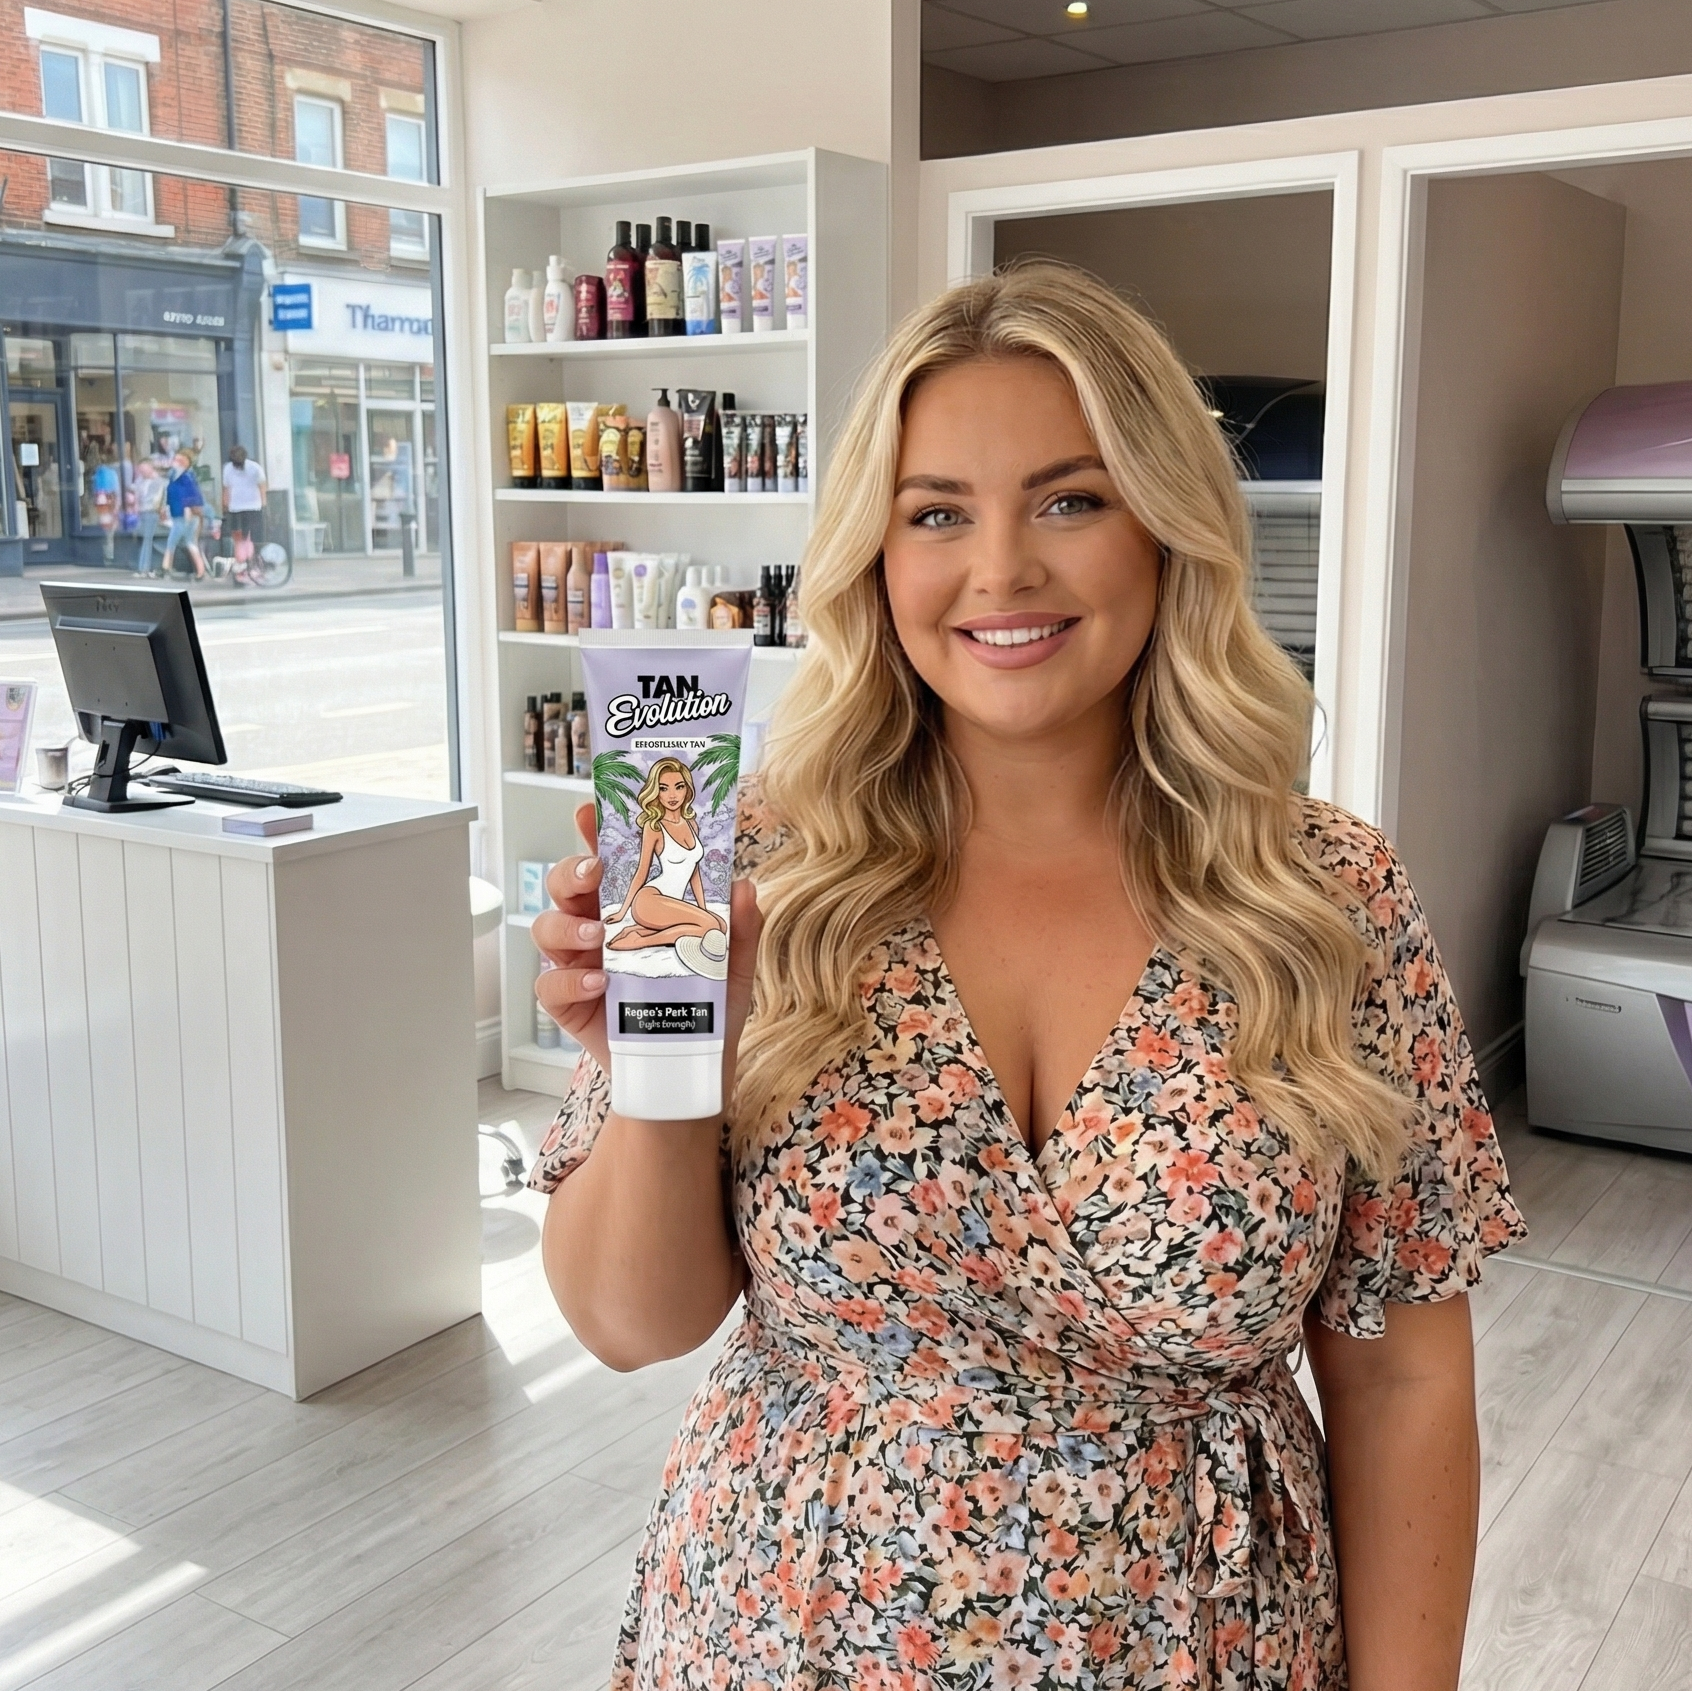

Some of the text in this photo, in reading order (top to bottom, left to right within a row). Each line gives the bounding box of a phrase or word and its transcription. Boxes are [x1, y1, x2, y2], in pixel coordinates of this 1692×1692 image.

[637, 675, 699, 699] TAN
[605, 689, 732, 738] Evolution
[690, 740, 706, 749] TAN
[665, 1006, 688, 1017] Perk
[690, 1007, 708, 1017] Tan
